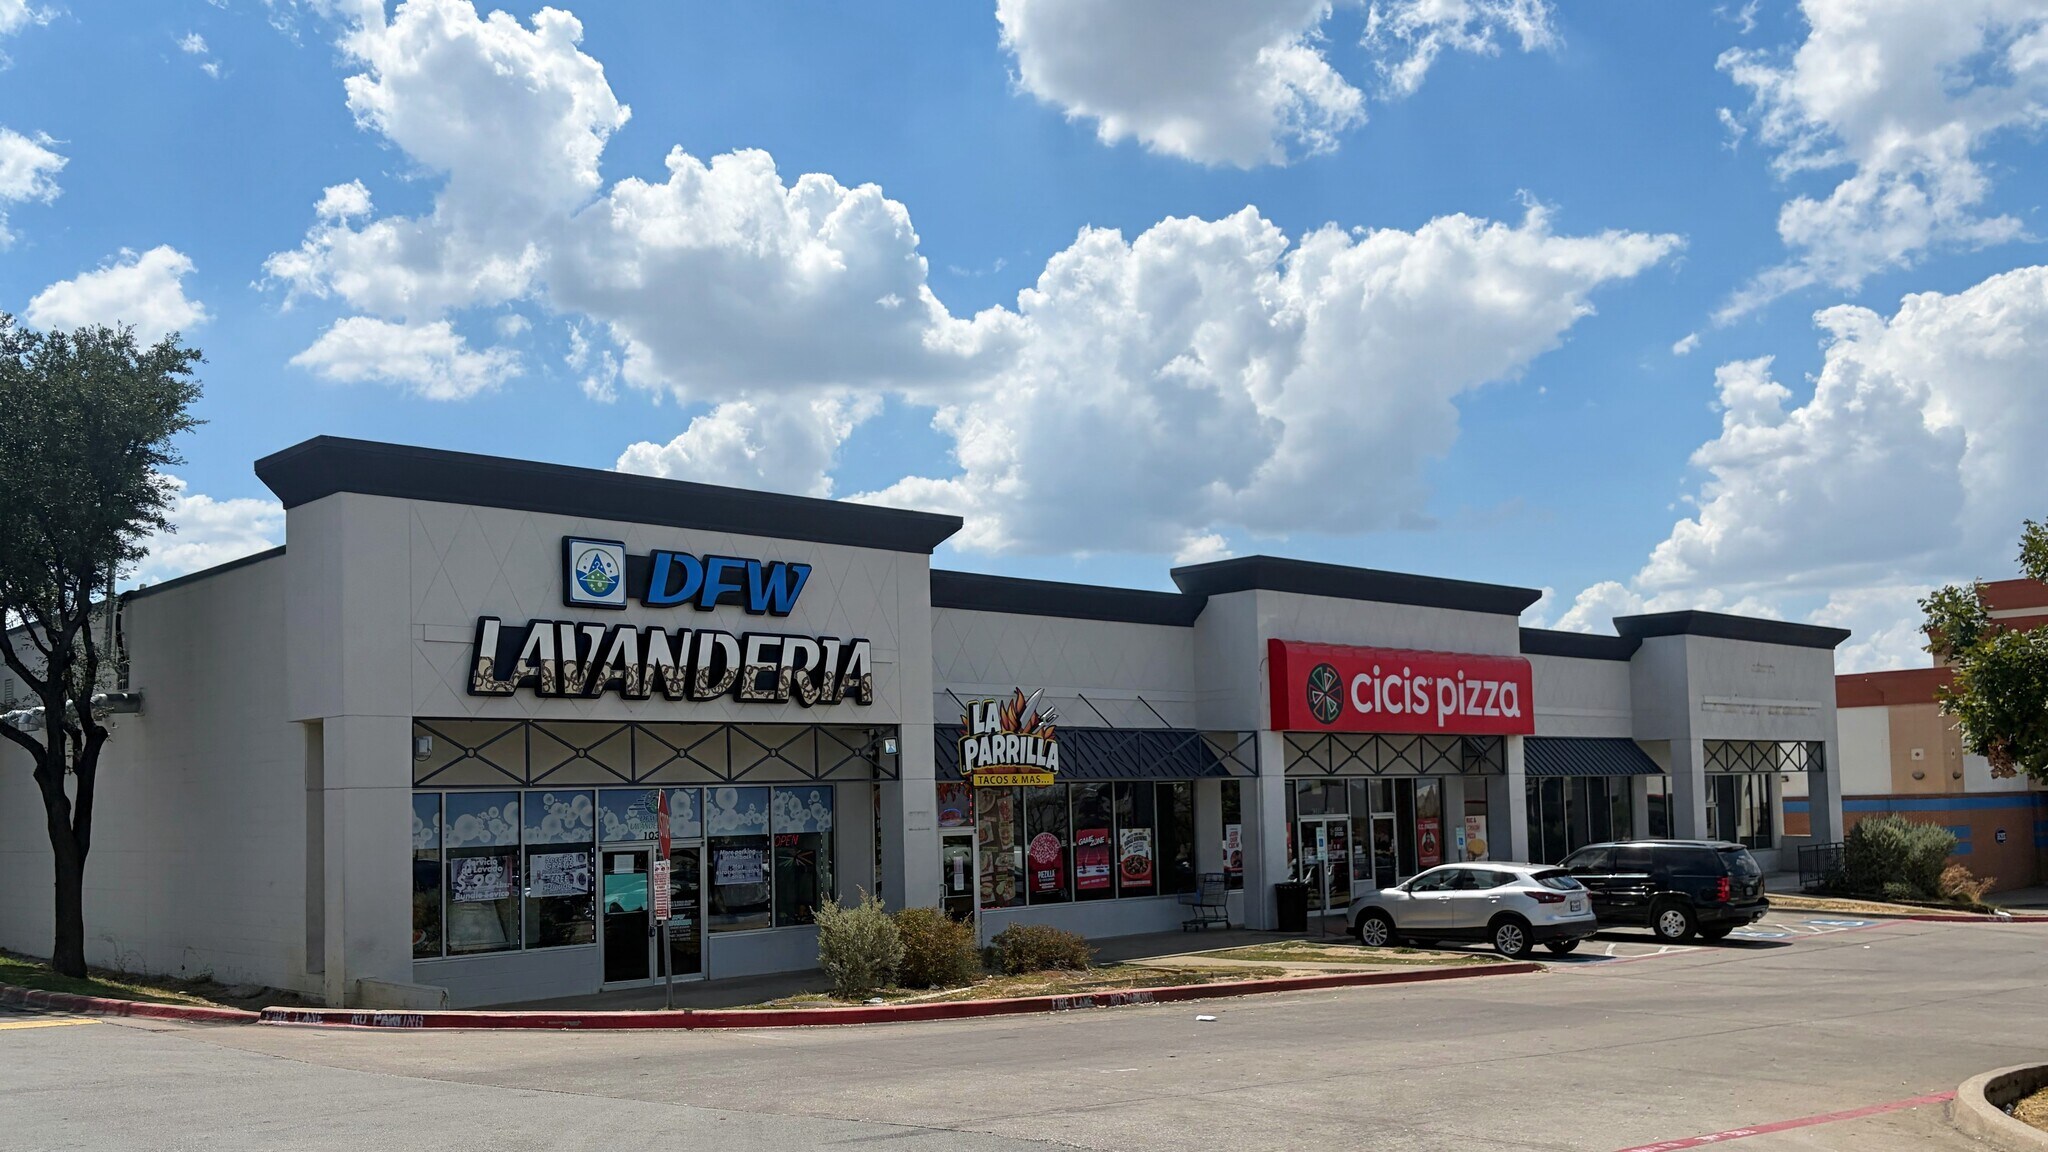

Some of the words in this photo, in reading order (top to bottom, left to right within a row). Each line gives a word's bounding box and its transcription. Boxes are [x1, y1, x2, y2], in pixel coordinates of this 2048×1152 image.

[644, 551, 812, 614] DFW
[470, 617, 873, 705] LAVANDERIA
[1437, 670, 1520, 727] pizza
[972, 702, 1002, 734] LA
[963, 734, 1060, 771] PARRILLA
[978, 775, 1009, 784] TACOS
[1012, 775, 1018, 784] &
[774, 835, 799, 847] OPEN
[1052, 996, 1071, 1010] FIRE
[351, 1013, 367, 1025] NO
[373, 1014, 424, 1027] PARKING
